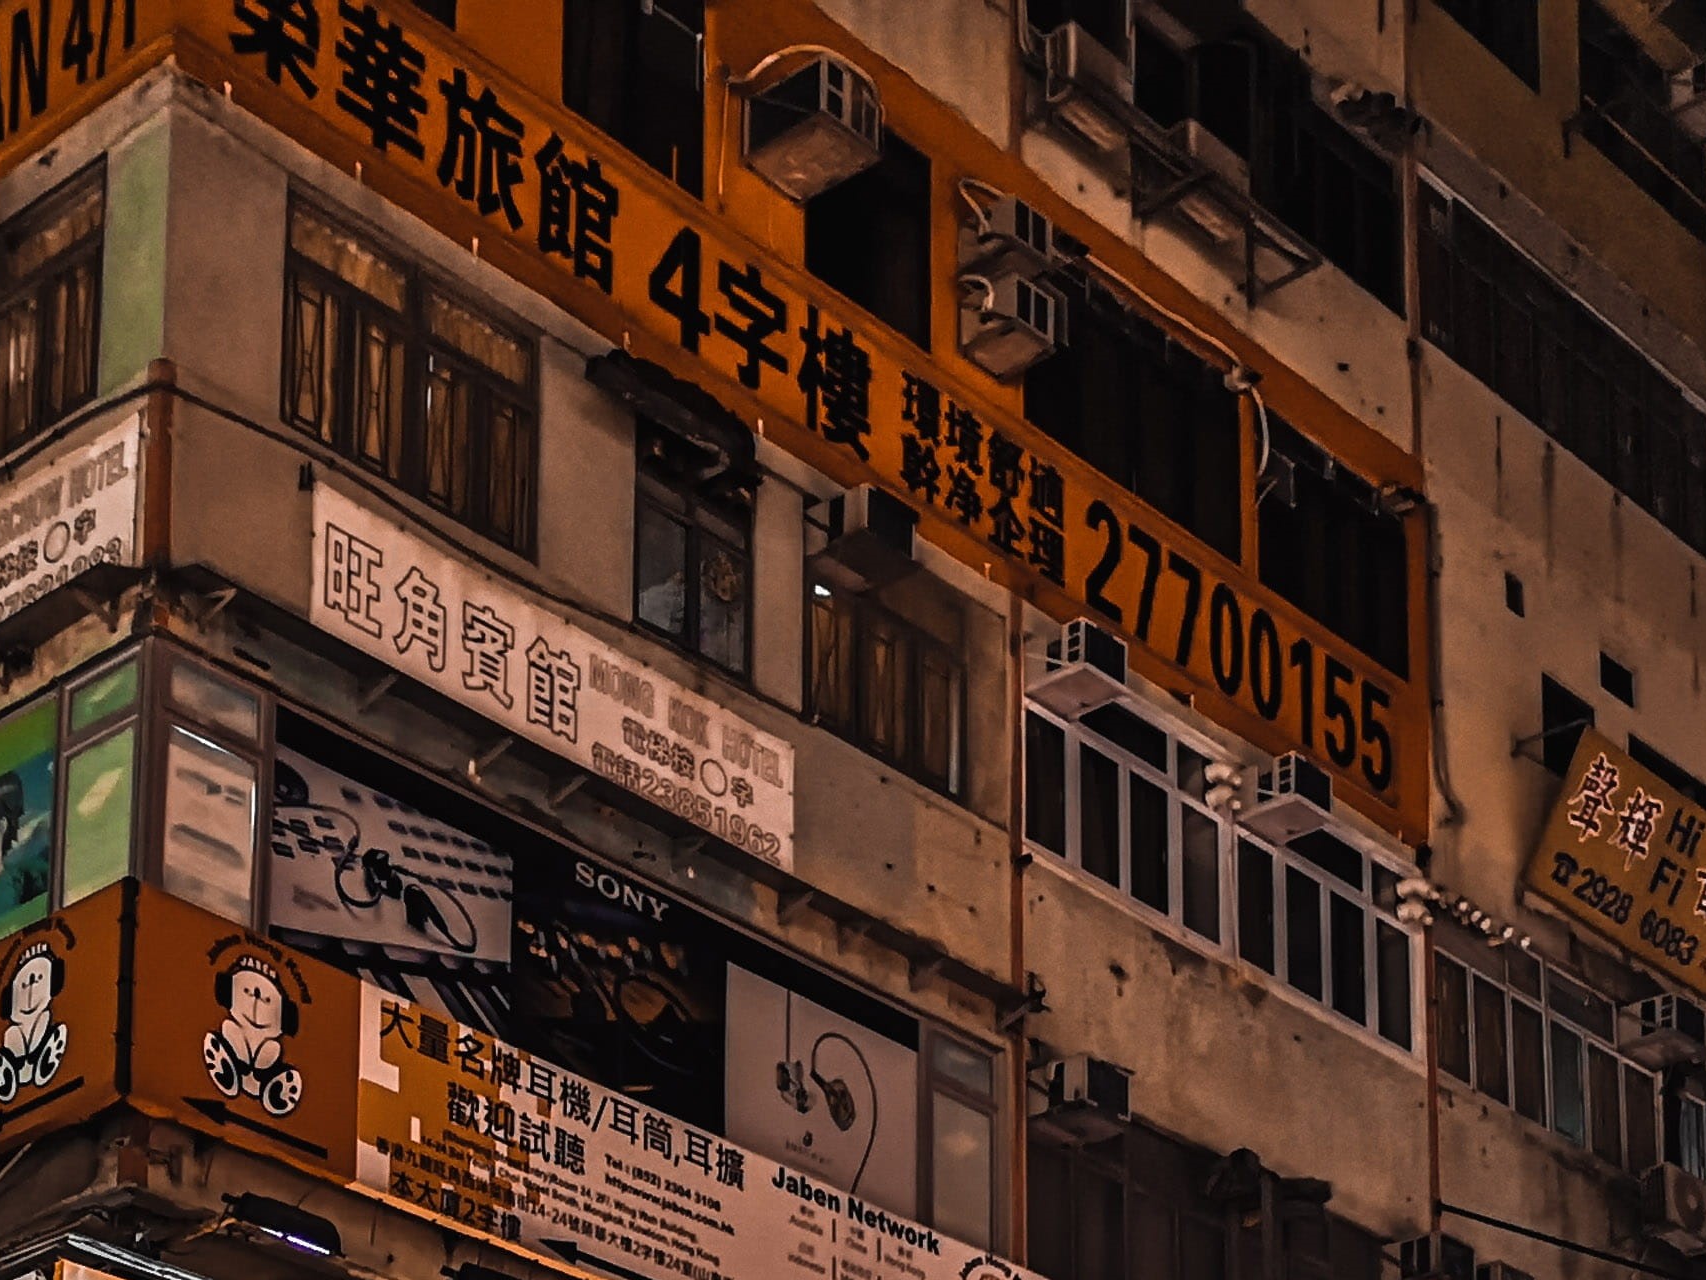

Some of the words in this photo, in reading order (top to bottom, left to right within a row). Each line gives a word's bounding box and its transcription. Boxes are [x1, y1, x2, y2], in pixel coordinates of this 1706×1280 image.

[648, 228, 872, 460] 4字樓
[325, 522, 581, 743] 旺角賓館
[1083, 499, 1392, 794] 27700155
[589, 652, 655, 718] MONG
[721, 726, 783, 787] HOTEL
[1666, 807, 1706, 858] Hi
[573, 860, 670, 922] SONY
[1573, 869, 1634, 925] 2928
[1639, 909, 1699, 966] 6083
[1649, 856, 1687, 906] Fi
[447, 1082, 586, 1175] 歡迎試聽
[772, 1167, 841, 1214] Jaben
[848, 1196, 941, 1255] Network
